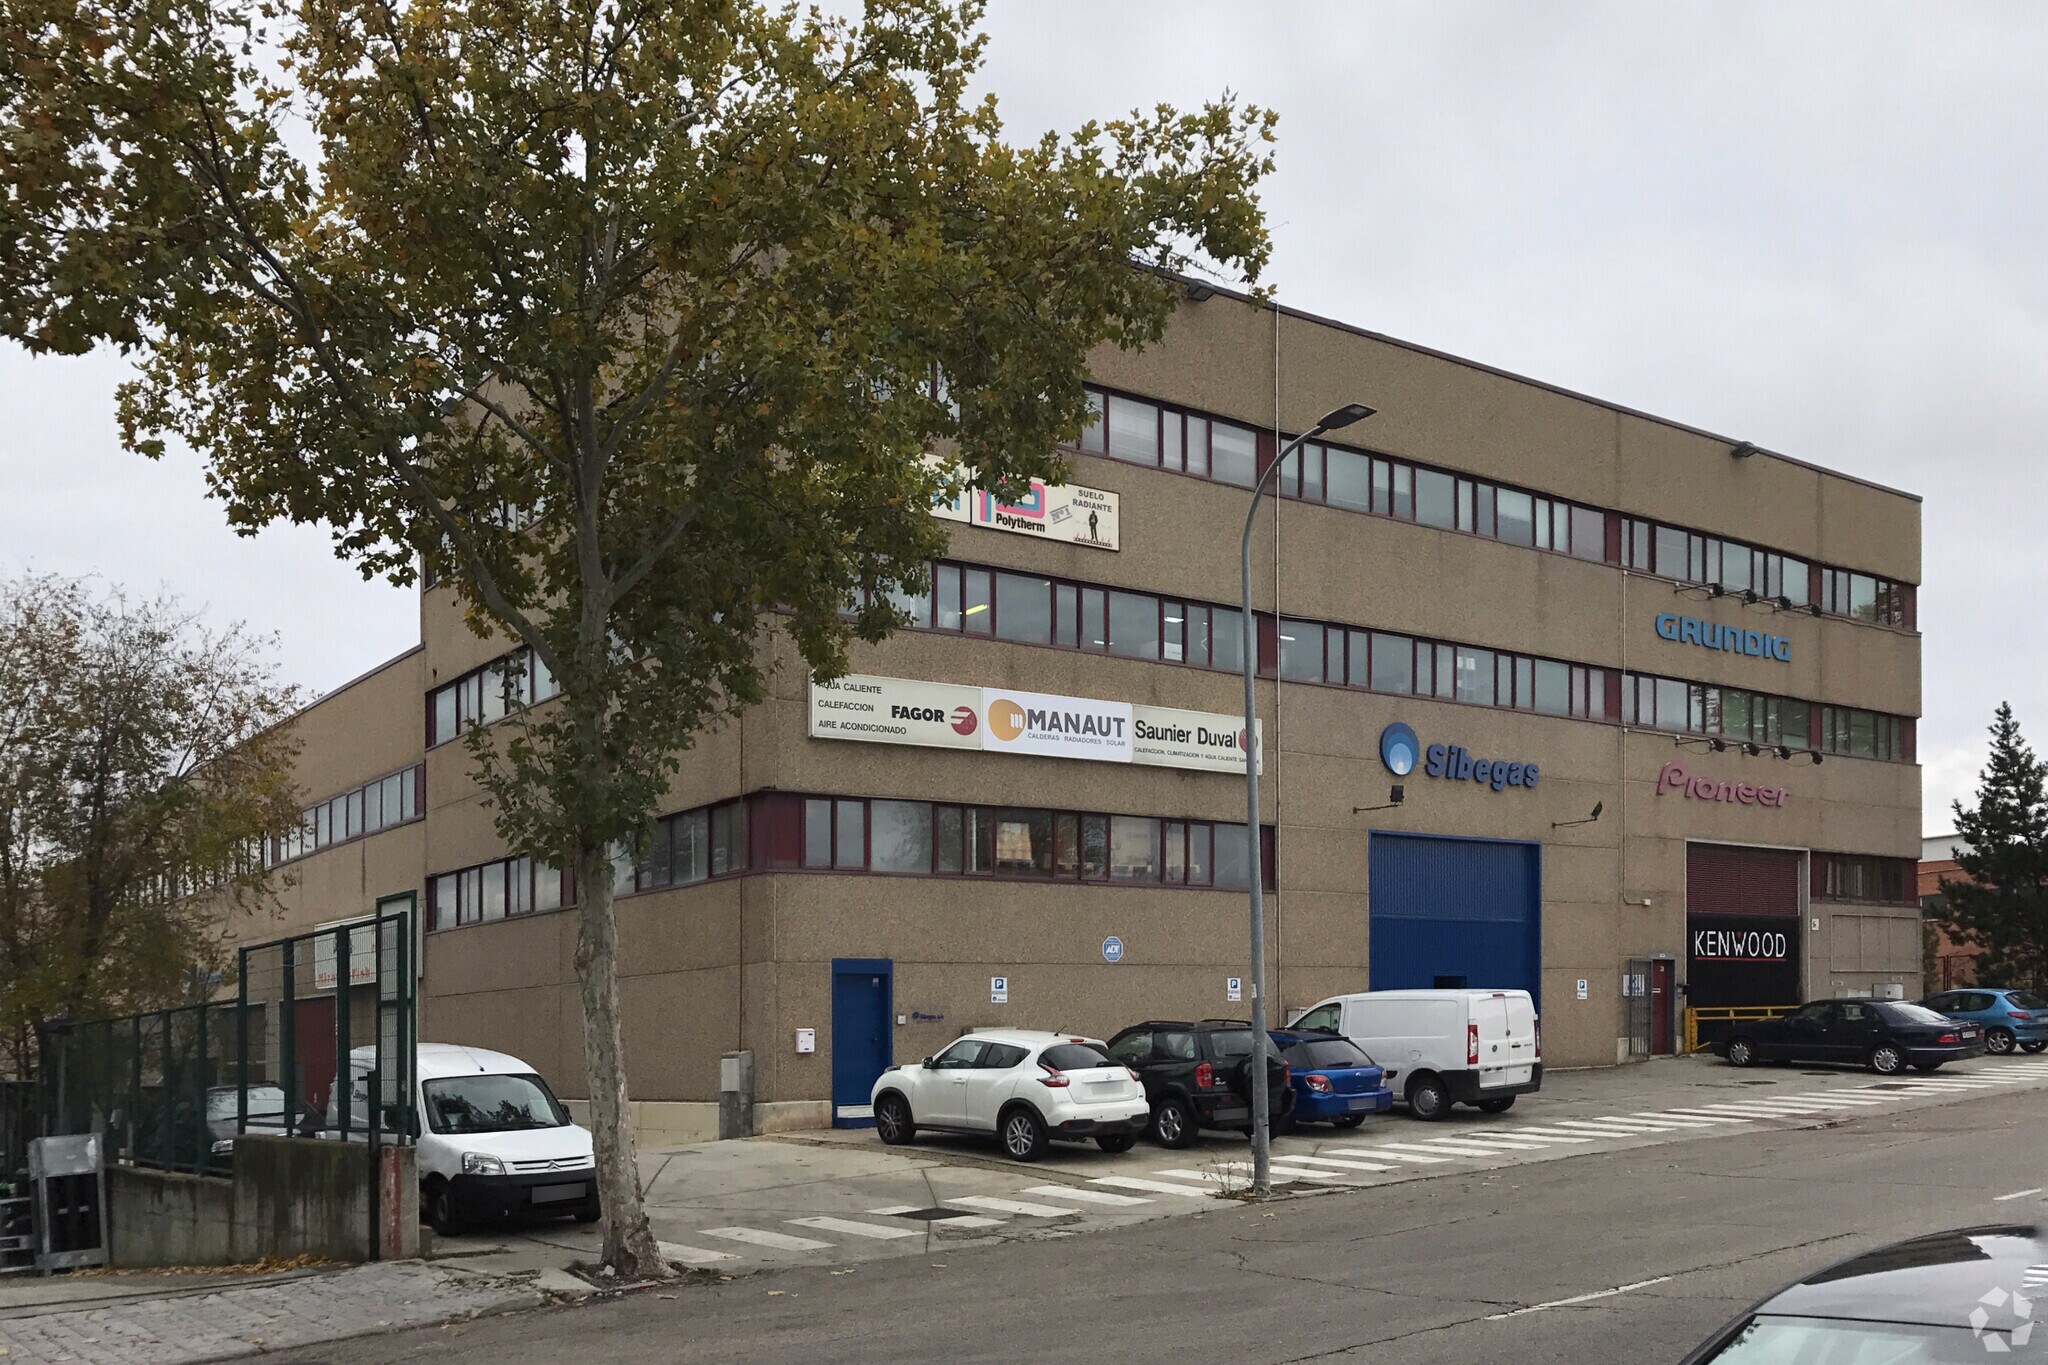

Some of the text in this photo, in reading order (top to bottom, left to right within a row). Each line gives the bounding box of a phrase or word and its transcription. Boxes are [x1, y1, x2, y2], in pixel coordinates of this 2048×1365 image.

[1078, 489, 1105, 501] SUELO
[1072, 498, 1113, 513] RADIANTE
[996, 512, 1046, 533] Polytherm
[1655, 612, 1792, 663] GRUNDIG
[843, 682, 882, 695] CALIENTE
[817, 699, 875, 713] CALEFACCION
[891, 704, 945, 723] FAGOR
[818, 719, 907, 735] AIRE ACONDICIONADO
[1027, 708, 1126, 738] MANAUT
[1027, 732, 1126, 747] CALDERAS RADIADORES SOLAR
[1135, 720, 1237, 749] Saunier Duval
[1425, 743, 1539, 791] Sibegas
[1656, 760, 1792, 807] Pioneer
[1694, 930, 1787, 958] KENWOOD
